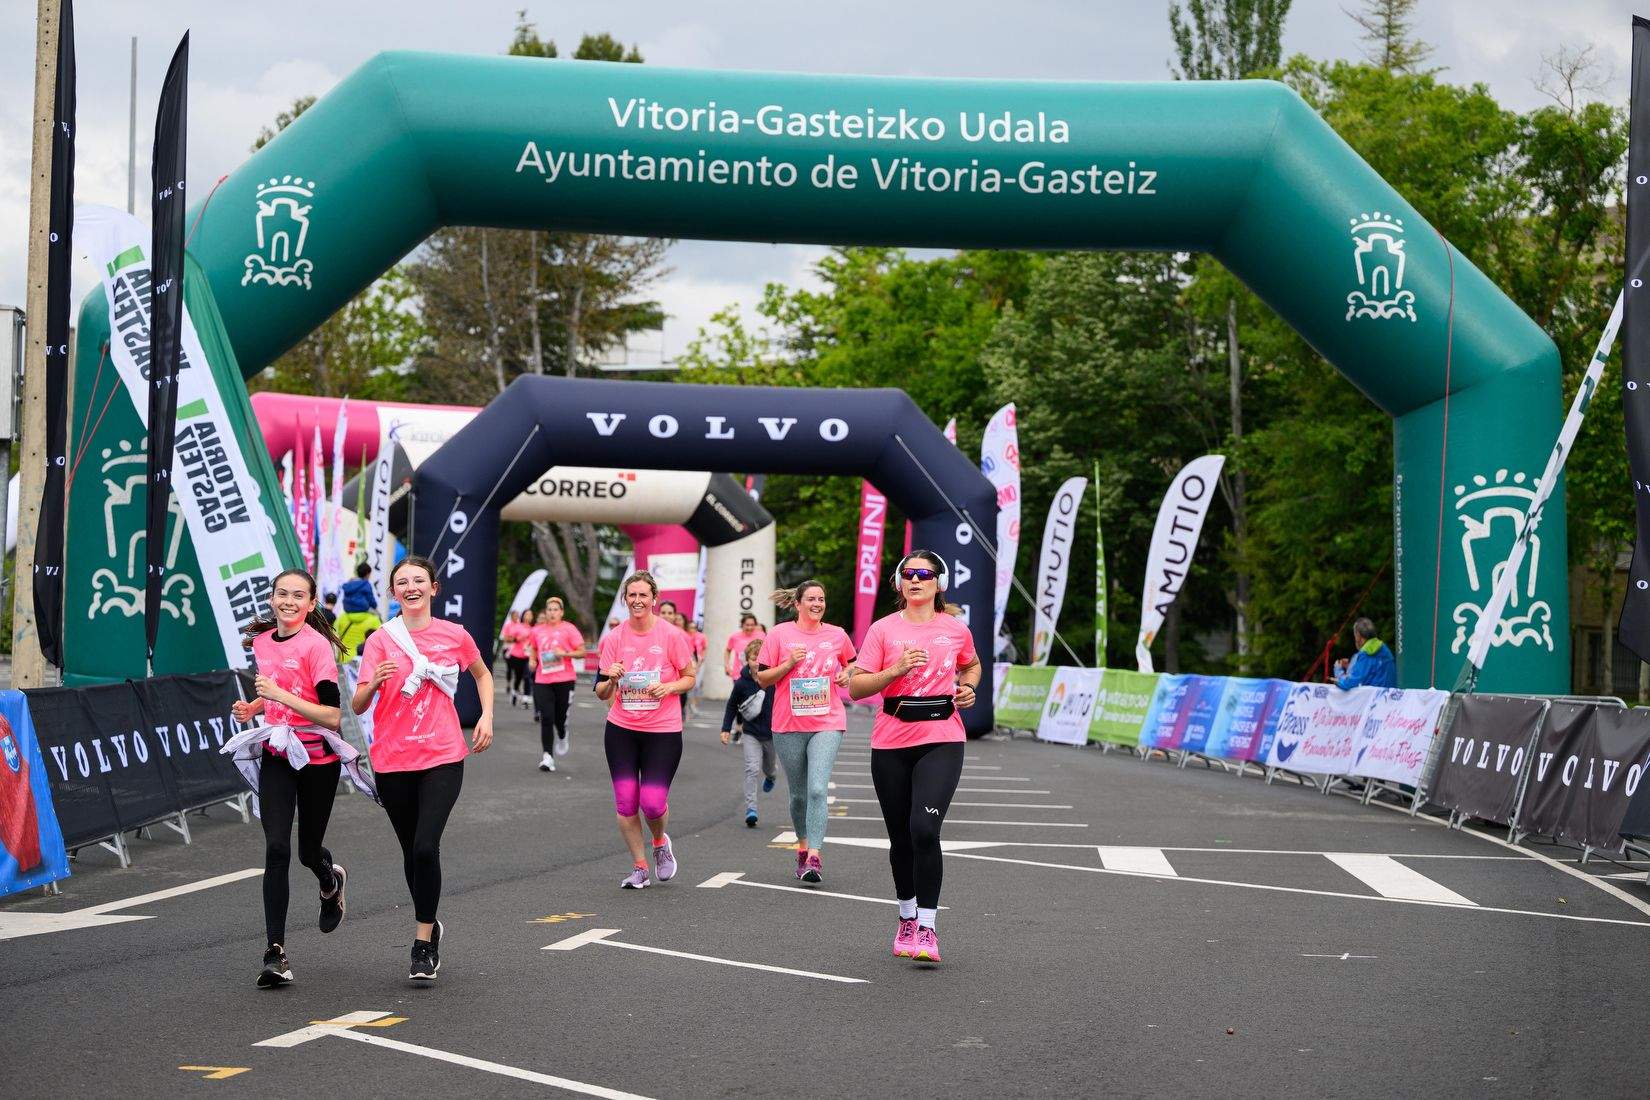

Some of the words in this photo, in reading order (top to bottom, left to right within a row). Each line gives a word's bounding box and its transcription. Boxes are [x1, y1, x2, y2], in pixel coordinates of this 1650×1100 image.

[607, 96, 946, 142] Vitoria-Gasteizko
[959, 111, 1071, 143] Udala
[515, 141, 798, 188] Ayuntamiento
[810, 154, 858, 190] de
[870, 156, 1157, 195] Vitoria-Gasteiz
[586, 412, 850, 442] VOLVO
[741, 559, 754, 580] EL
[859, 493, 886, 596] DRUNI
[1041, 492, 1074, 620] AMUTIO
[1155, 475, 1206, 618] AMUTIO
[51, 730, 149, 781] VOLVO
[1450, 736, 1524, 776] VOLVO
